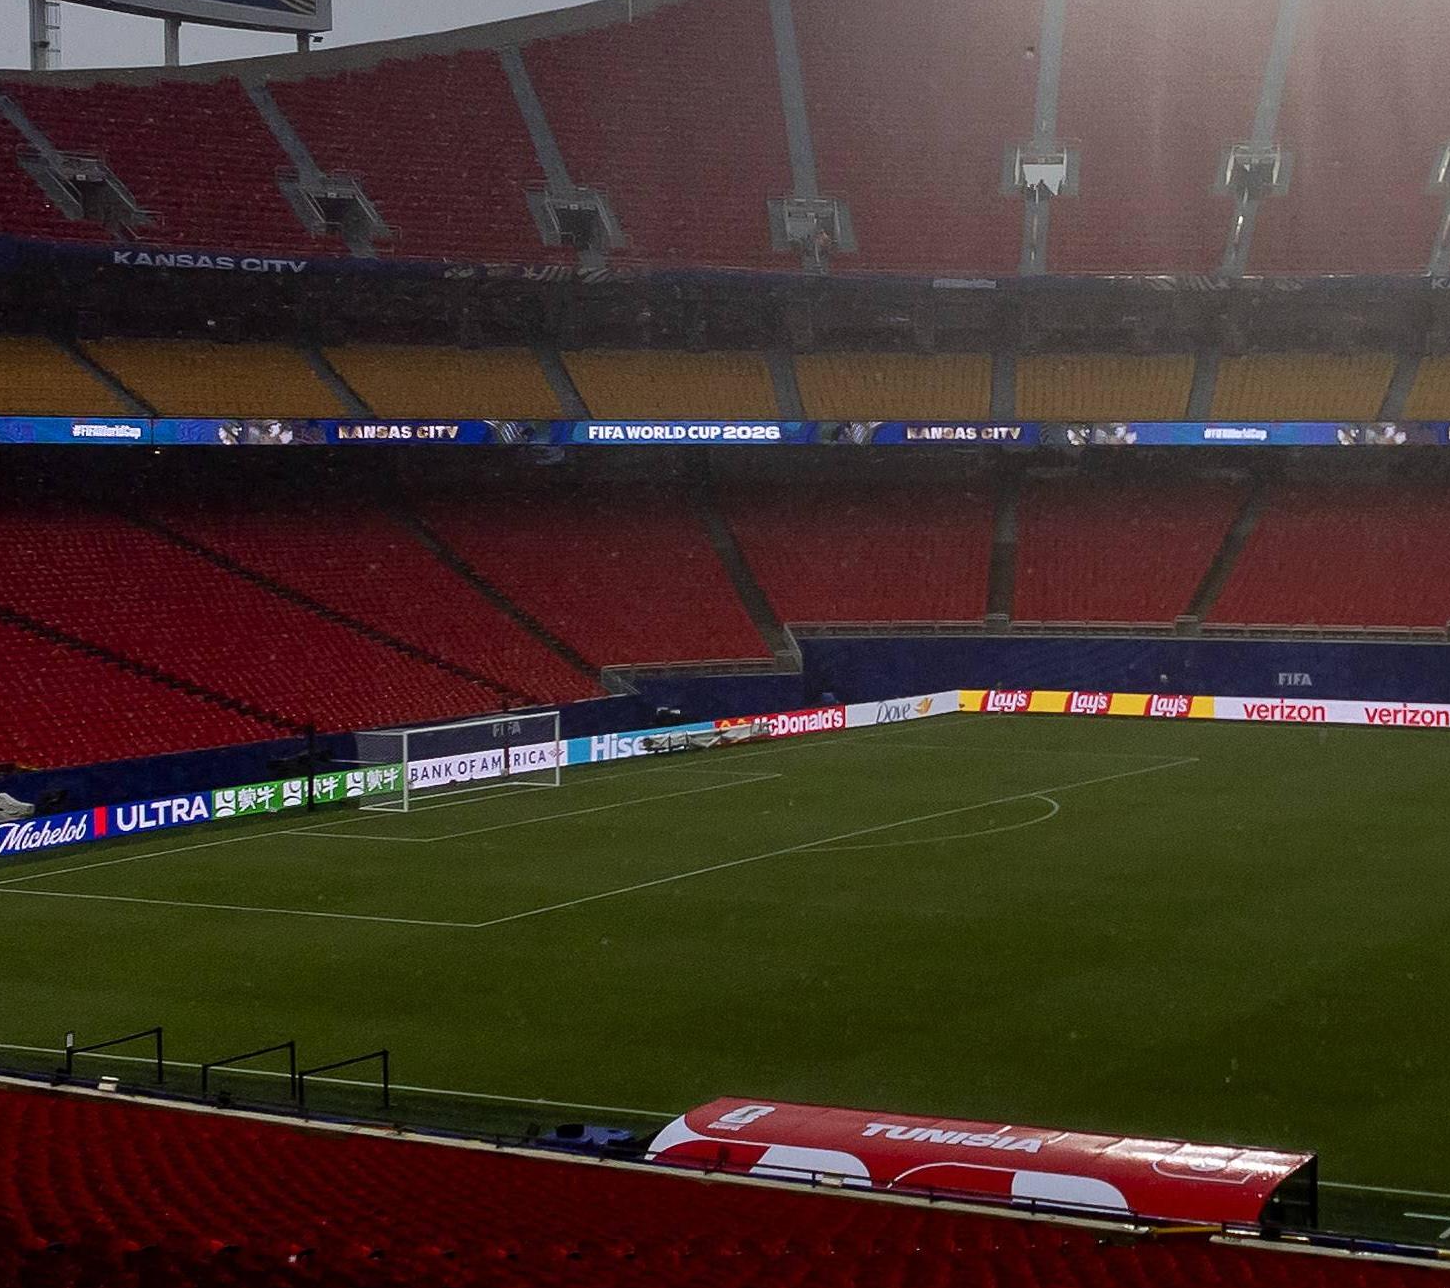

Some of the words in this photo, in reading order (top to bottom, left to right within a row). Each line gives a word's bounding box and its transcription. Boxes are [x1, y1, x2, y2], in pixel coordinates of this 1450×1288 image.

[113, 251, 234, 271] KANSAS
[240, 258, 308, 272] CITY
[338, 425, 412, 439] KANSAS
[416, 425, 459, 439] CITY
[588, 425, 625, 439] FIFA
[626, 425, 686, 439] WORLD
[687, 425, 721, 440] CUP
[722, 425, 780, 440] 2026
[907, 427, 977, 440] KANSAS
[981, 427, 1021, 440] CITY
[1278, 672, 1313, 686] FIFA
[876, 701, 911, 724] Dove
[985, 690, 1028, 713] Lay's
[1070, 691, 1109, 715] Lay's
[1150, 694, 1188, 717] Lay's
[1243, 698, 1326, 722] verizon
[1365, 703, 1450, 726] verizon
[410, 762, 453, 785] BANK
[457, 759, 476, 776] OF
[481, 750, 547, 771] AMRICA
[116, 796, 210, 832] ULTRA
[862, 1122, 1043, 1154] TUNISIA
